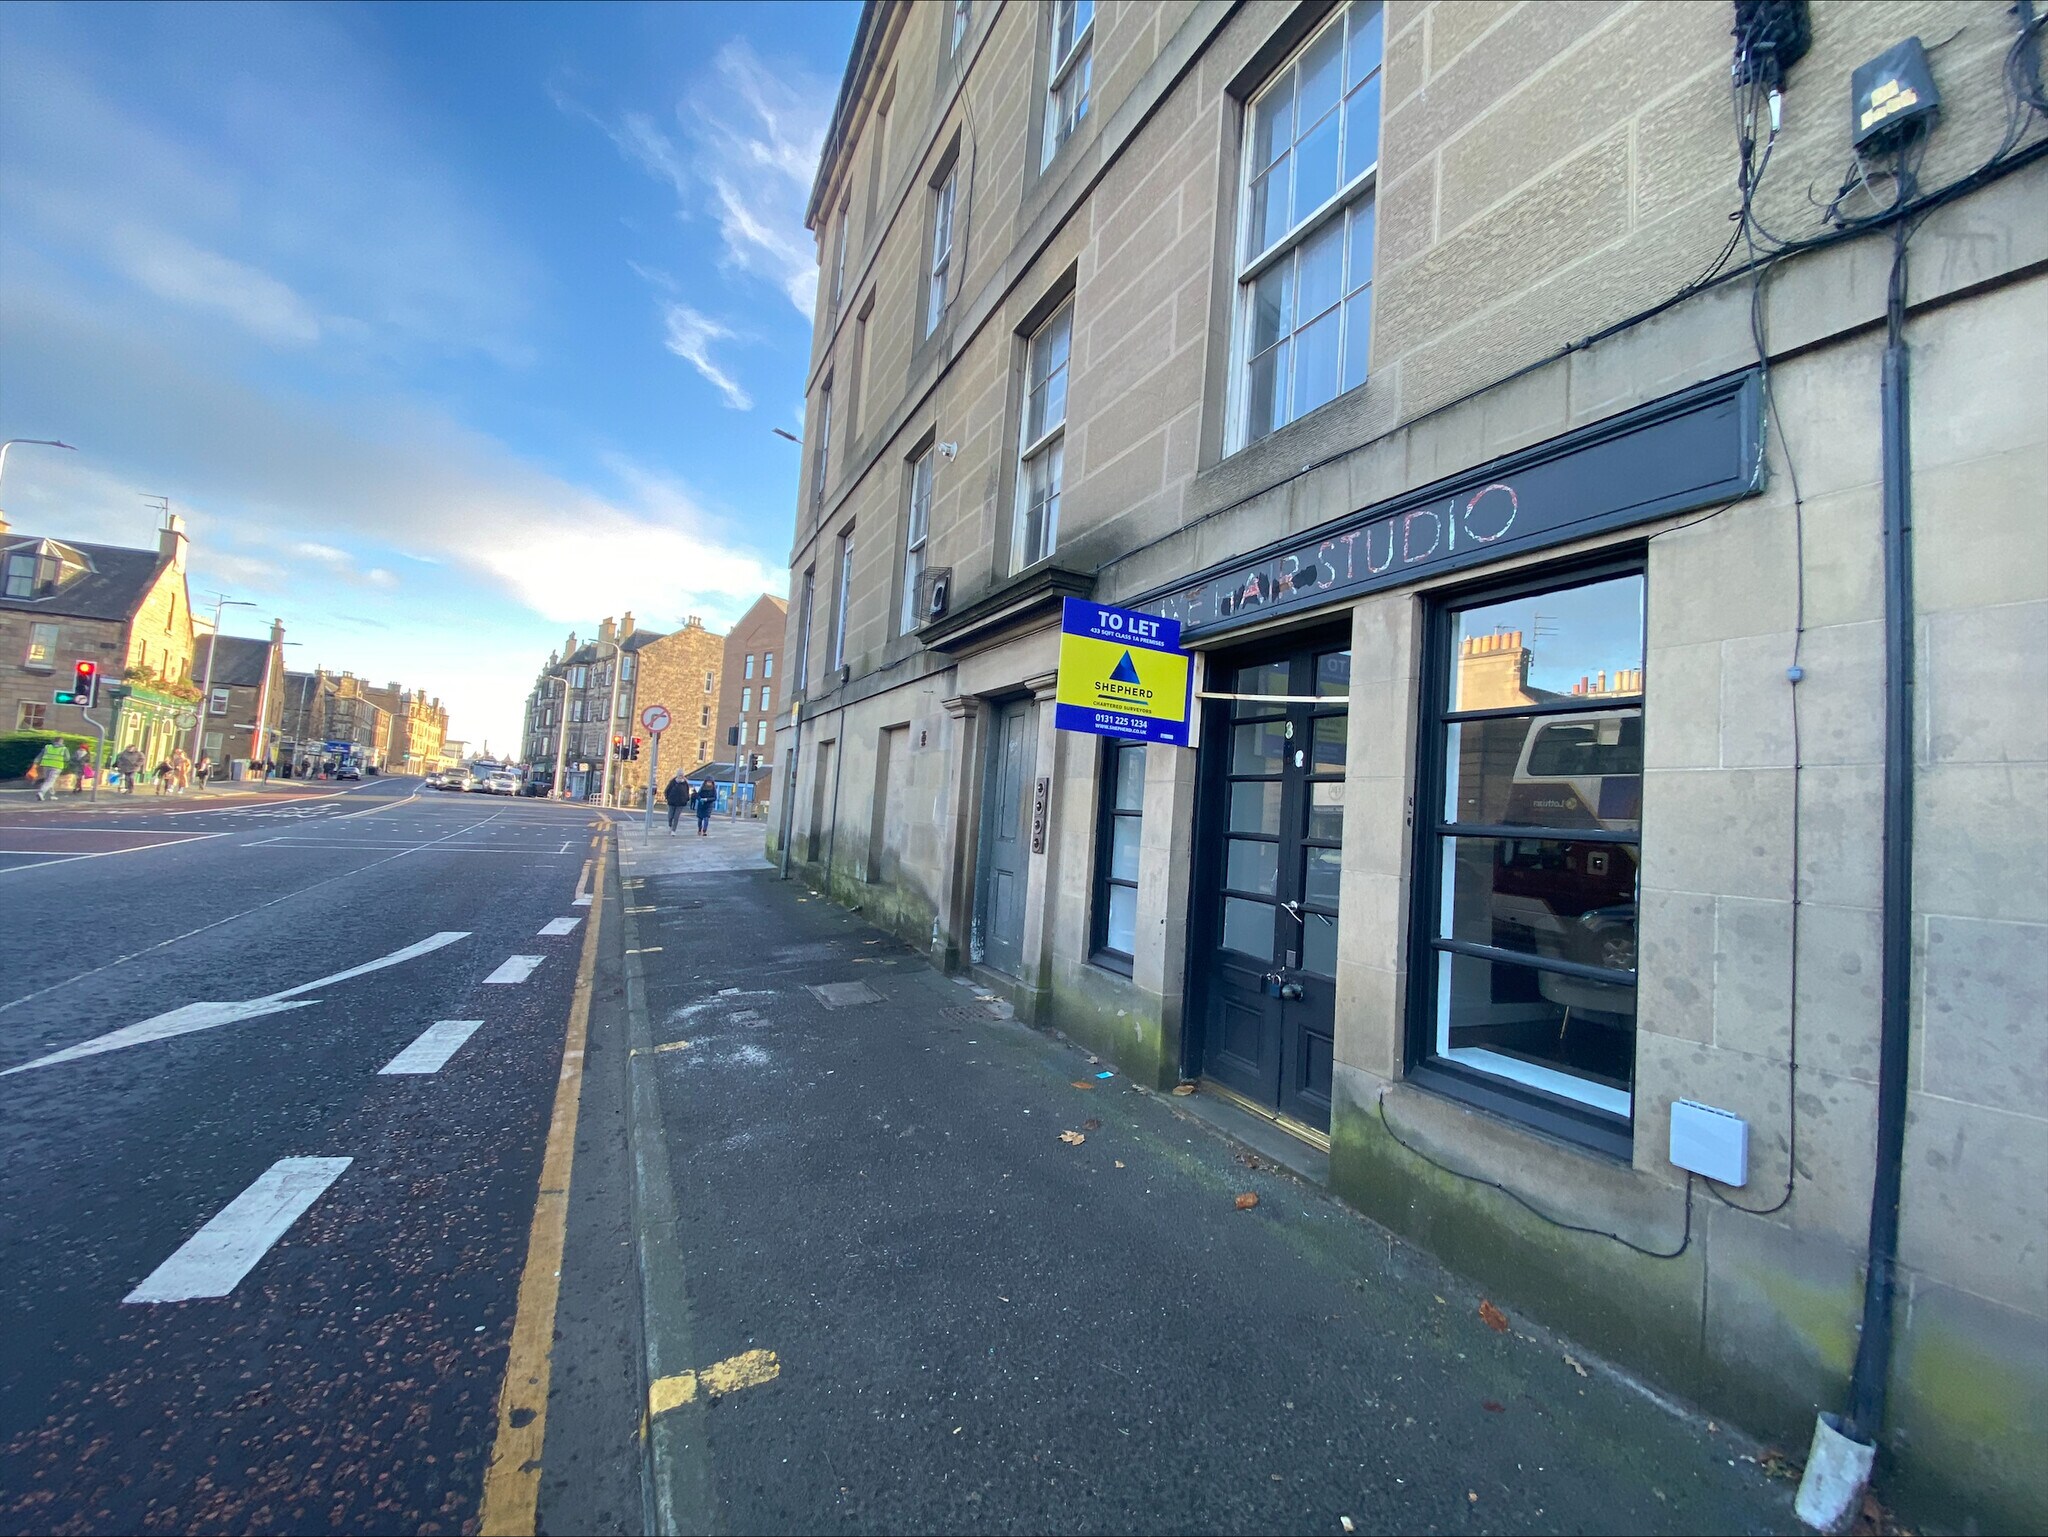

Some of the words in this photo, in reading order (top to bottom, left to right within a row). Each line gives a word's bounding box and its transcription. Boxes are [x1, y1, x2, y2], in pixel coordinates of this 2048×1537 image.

[1317, 483, 1518, 589] STUDIO
[1098, 611, 1123, 630] TO
[1128, 617, 1160, 638] LET
[1115, 632, 1132, 641] CLASS
[1140, 637, 1165, 647] PREMISES
[1094, 681, 1153, 699] SHEPHERD
[1093, 700, 1123, 710] CHARTERED
[1123, 705, 1152, 714] SURVEYORS
[1095, 713, 1113, 724] 0131
[1115, 716, 1129, 726] 225
[1130, 719, 1148, 729] 1234
